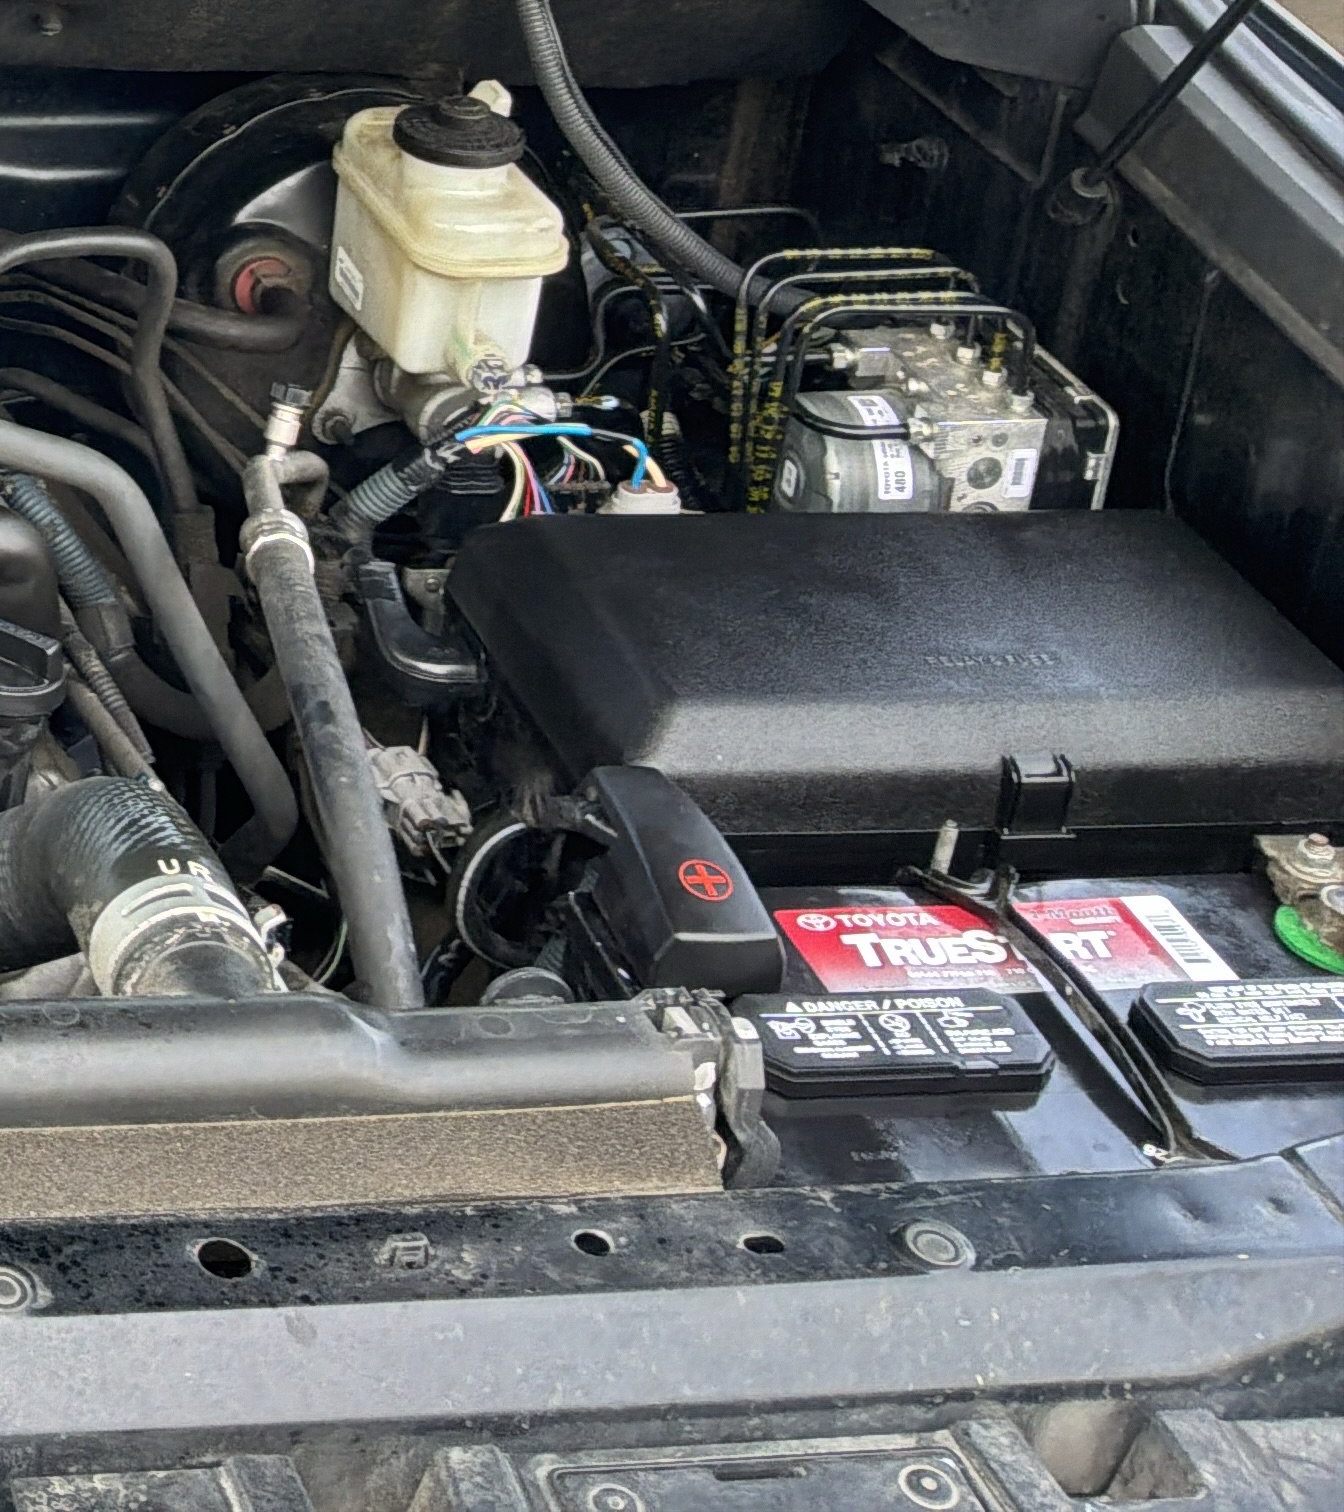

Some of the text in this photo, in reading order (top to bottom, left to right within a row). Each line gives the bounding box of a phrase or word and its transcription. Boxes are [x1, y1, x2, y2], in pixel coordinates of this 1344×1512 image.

[834, 911, 941, 929] TOYOTA
[801, 1000, 880, 1013] DANGER
[894, 996, 964, 1010] POISON
